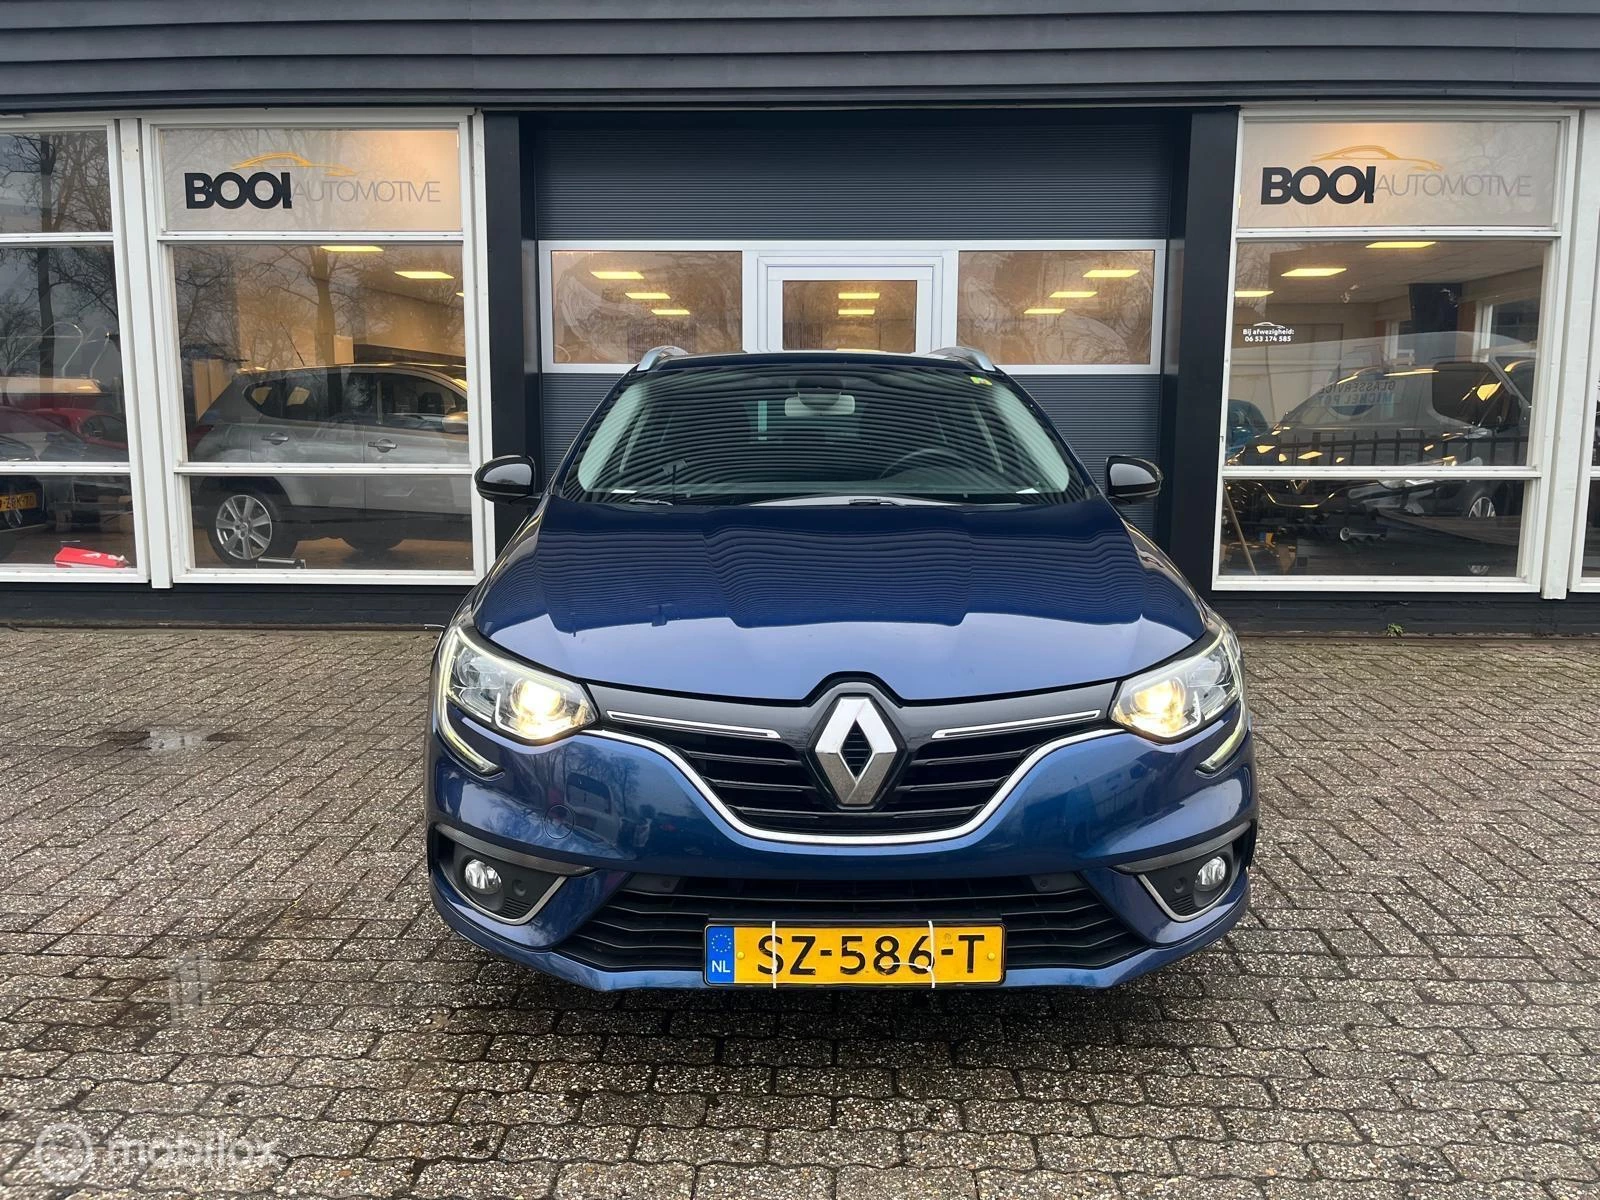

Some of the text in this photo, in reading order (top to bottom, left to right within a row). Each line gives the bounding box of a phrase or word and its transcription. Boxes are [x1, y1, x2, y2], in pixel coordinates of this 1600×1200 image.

[184, 172, 441, 209] BOOI AUTOMOTIVE
[1261, 165, 1532, 205] BOOI AUTOMOTIVE
[1252, 328, 1295, 336] afwezigheid:
[711, 934, 985, 976] NL SZ-586-T
